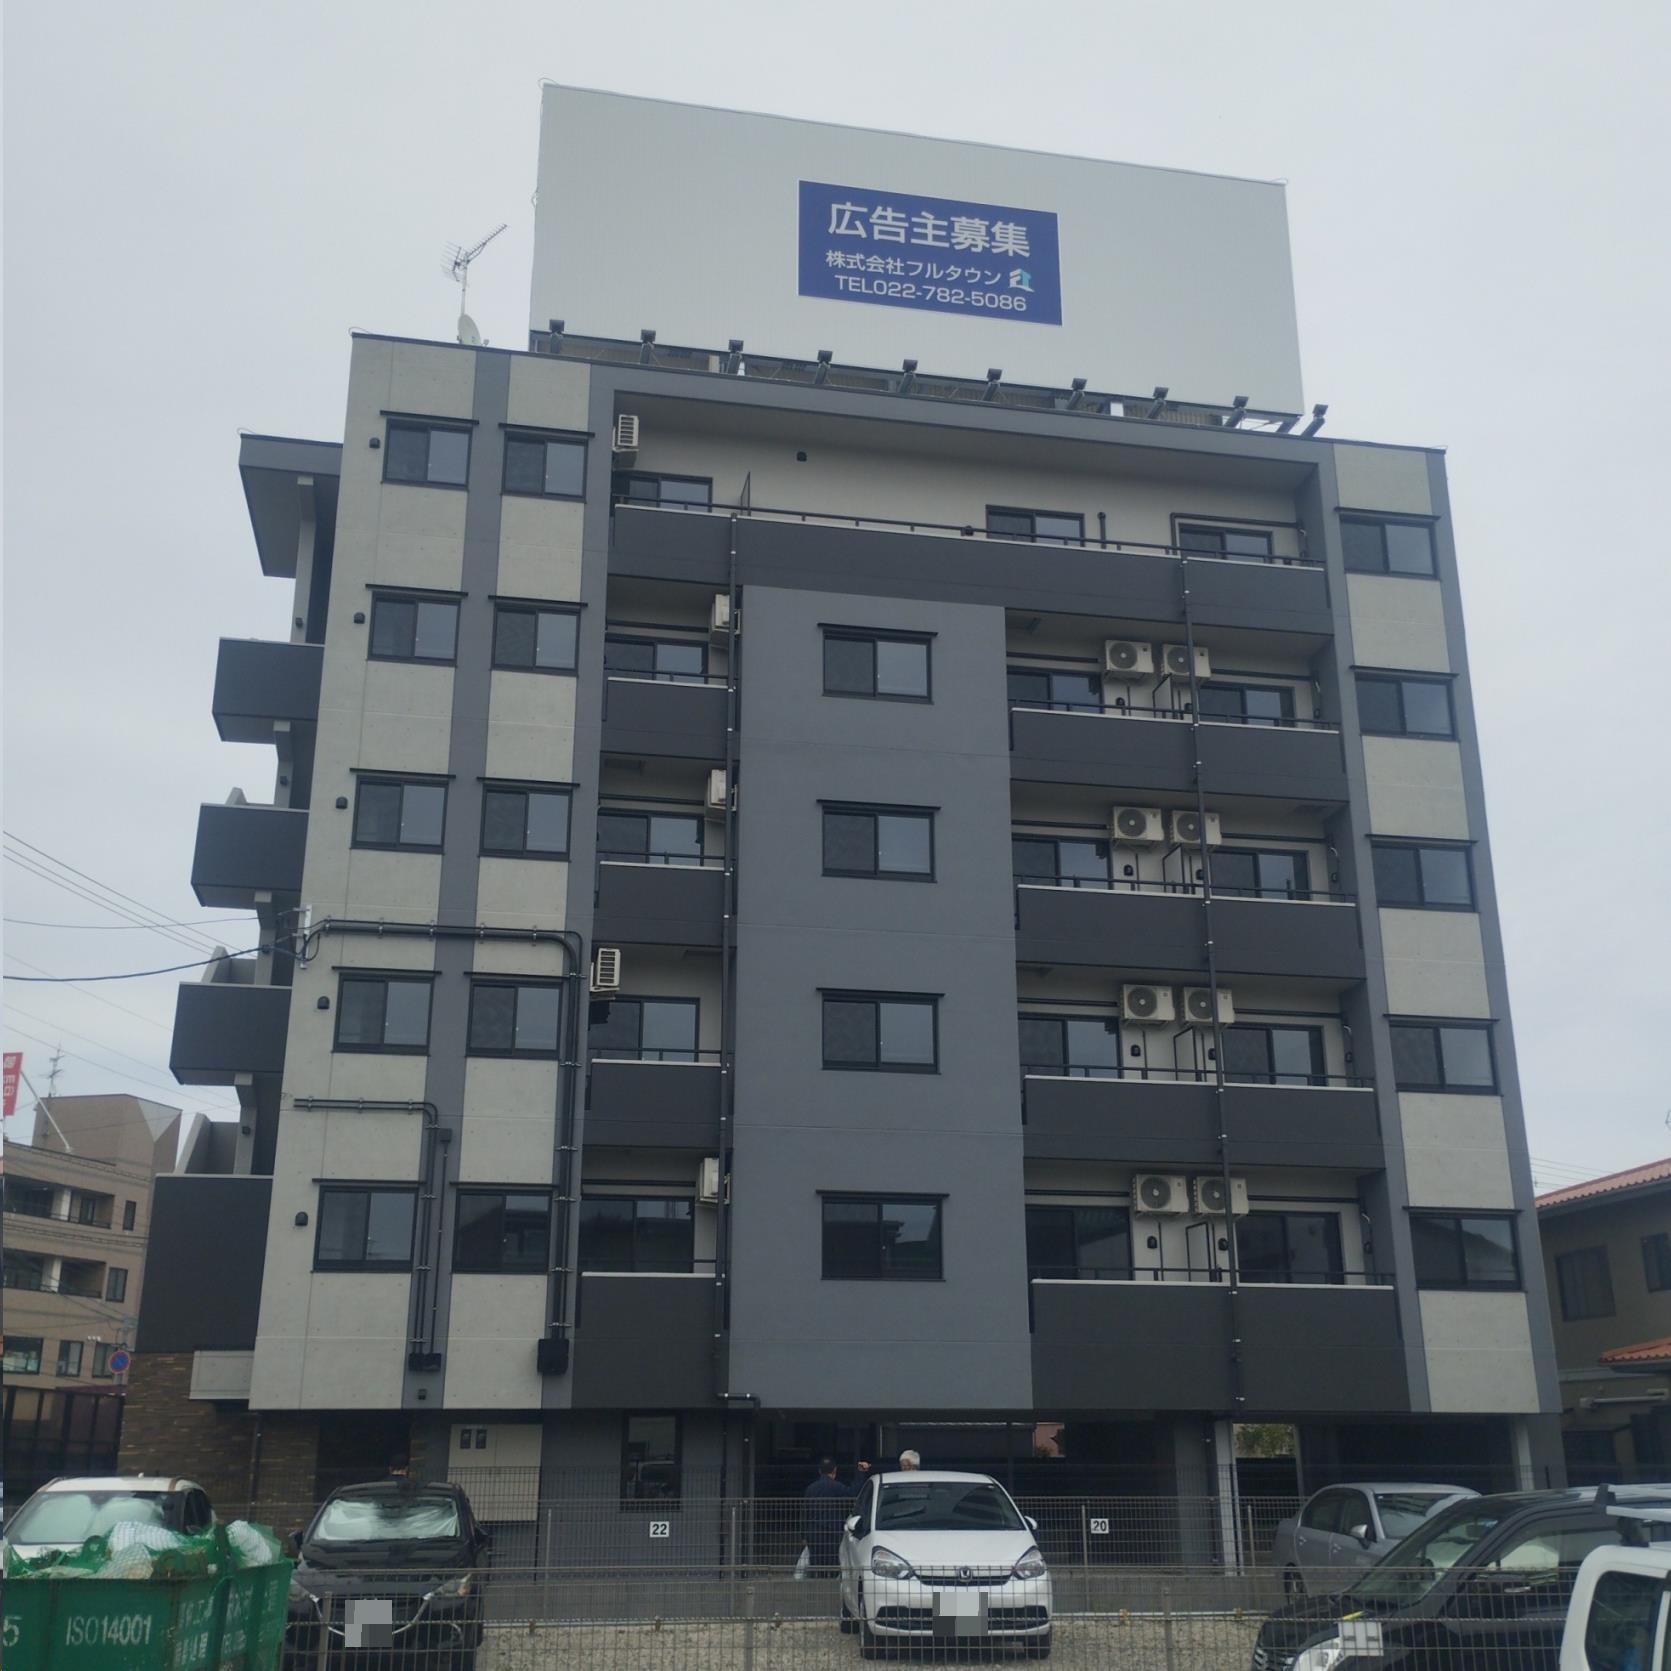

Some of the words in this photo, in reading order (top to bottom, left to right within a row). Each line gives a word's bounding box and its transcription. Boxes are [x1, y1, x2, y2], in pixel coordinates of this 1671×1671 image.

[828, 202, 1030, 257] 広告主募集
[825, 249, 1001, 286] 株式会社フルタウン
[834, 274, 1027, 311] TEL022-782-5086
[652, 1523, 667, 1536] 22
[1092, 1520, 1107, 1532] 20
